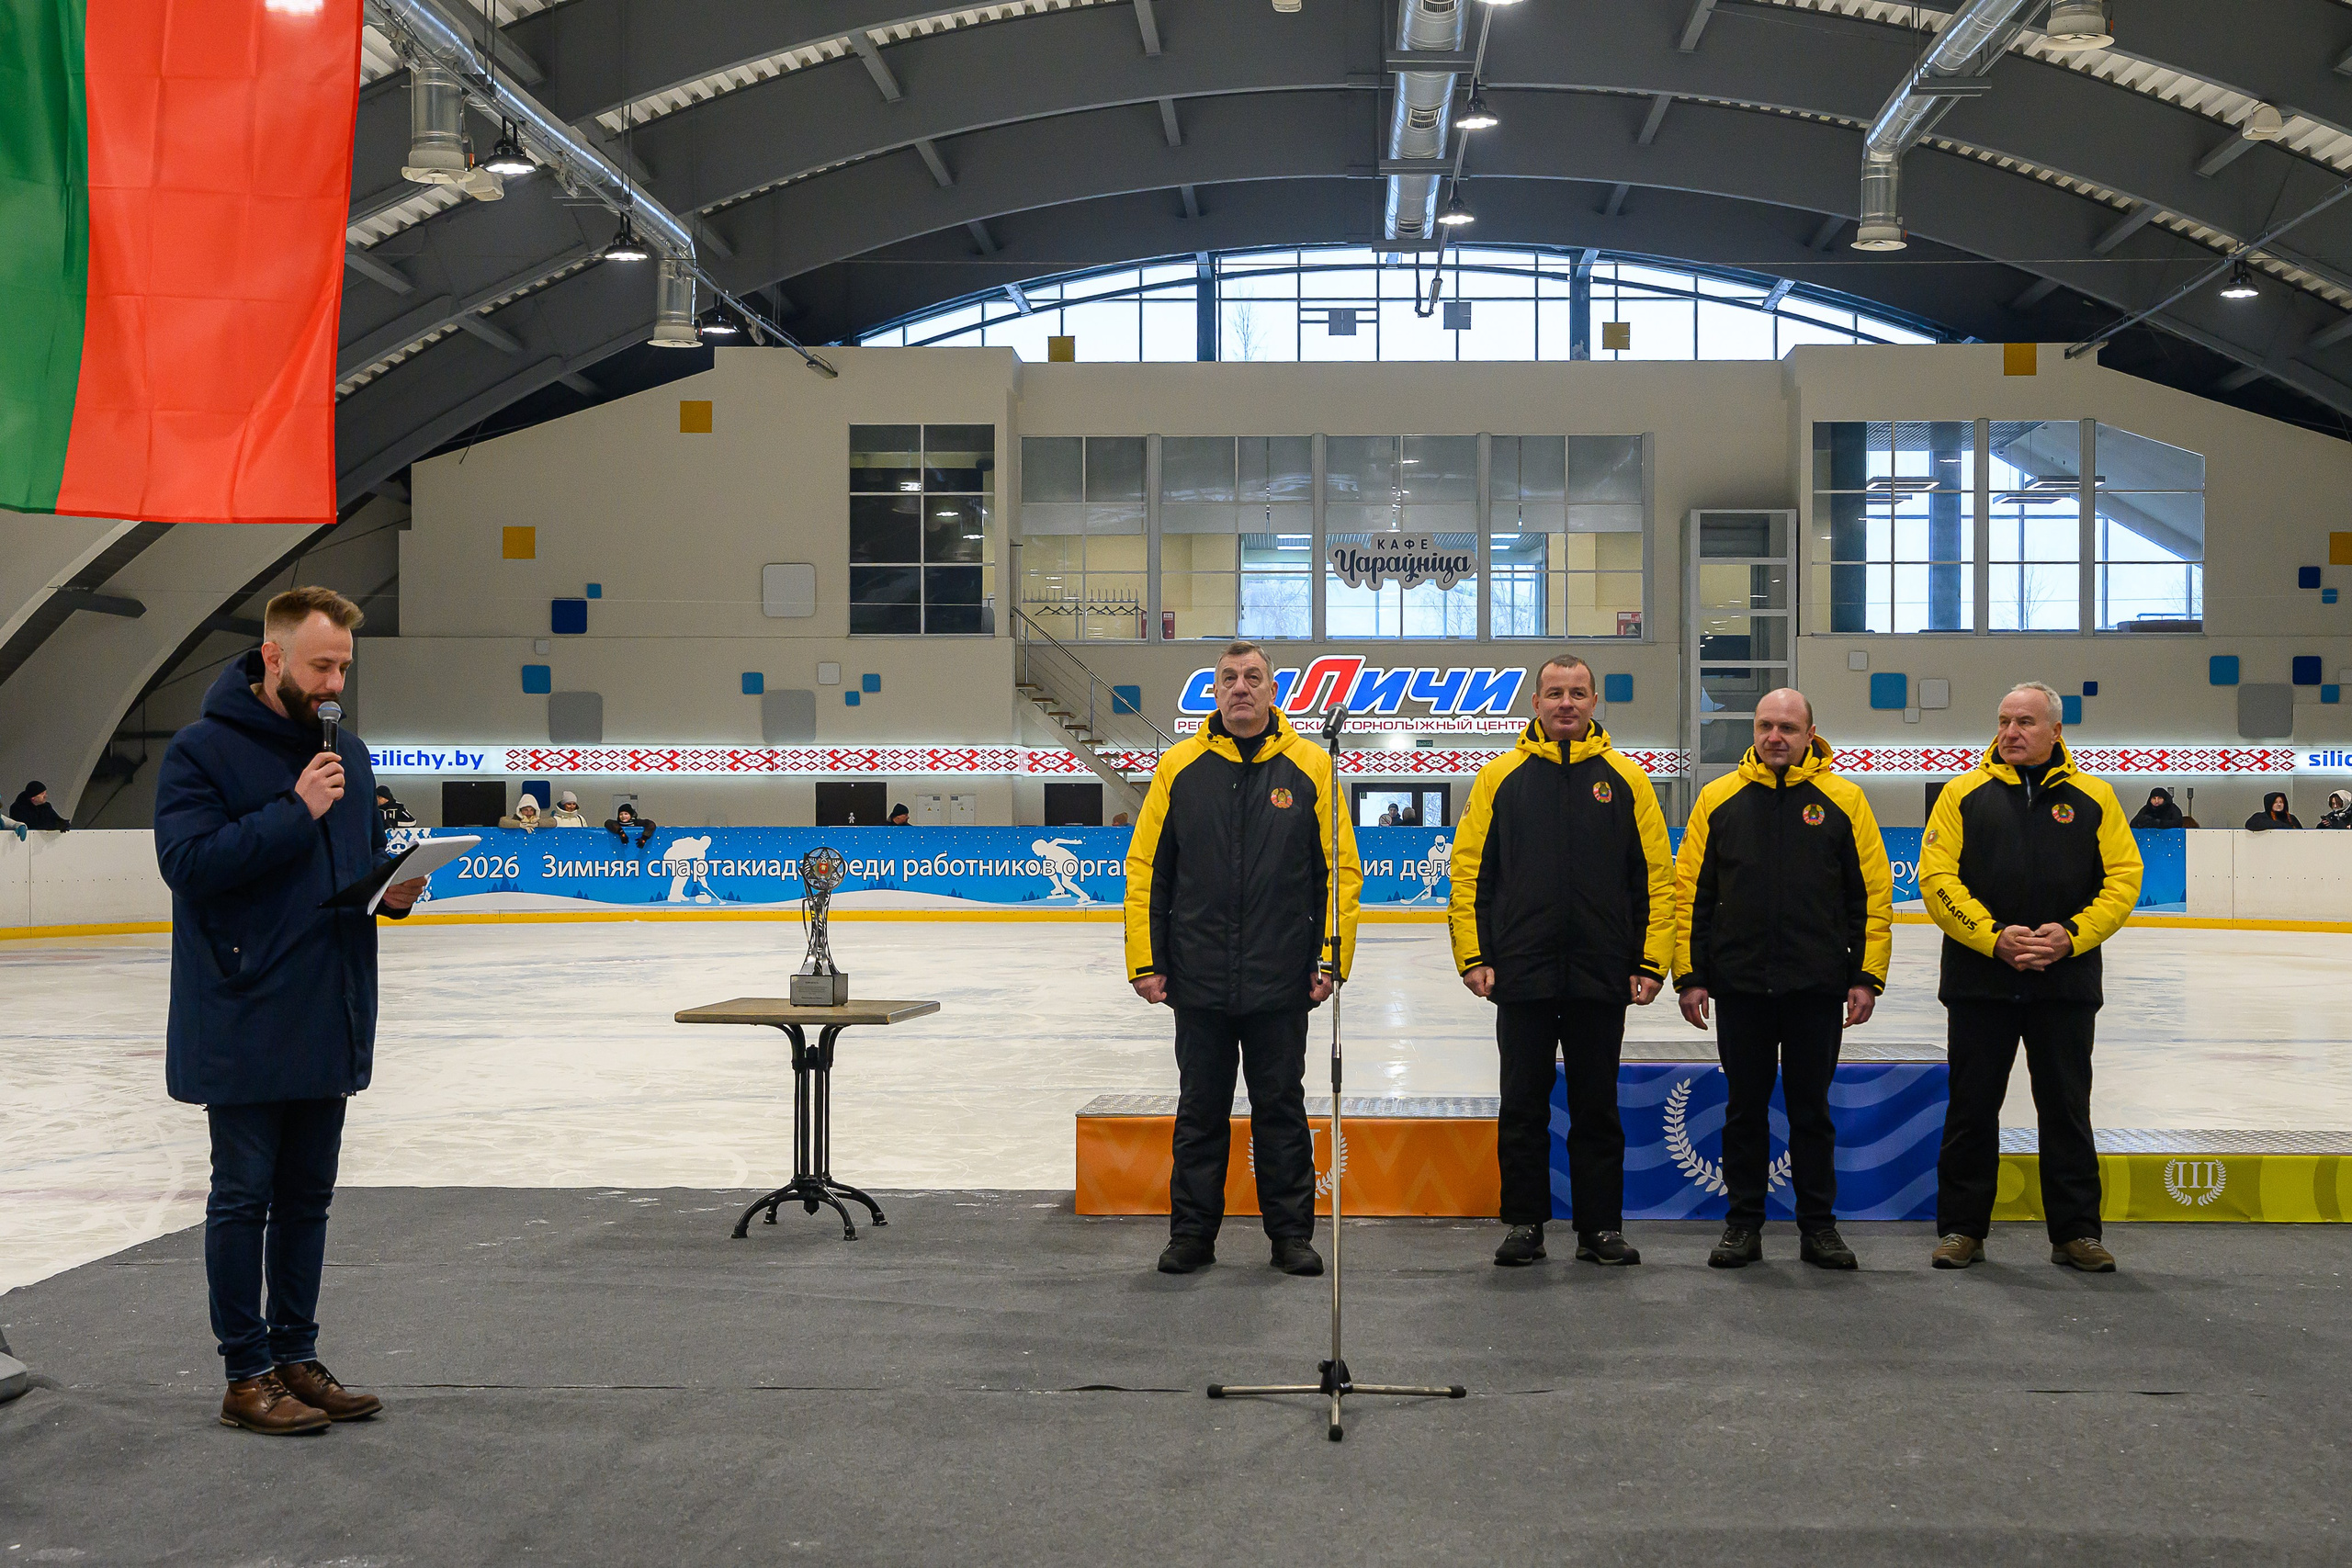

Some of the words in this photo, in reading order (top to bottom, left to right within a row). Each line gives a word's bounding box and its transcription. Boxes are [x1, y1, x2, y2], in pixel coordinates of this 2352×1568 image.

[1377, 538, 1429, 550] КАФЕ
[1334, 548, 1472, 584] Чараўніца
[1343, 718, 1473, 731] ГОРНОЛЫЖНЫЙ
[1476, 720, 1527, 733] ЦЕНТР
[369, 750, 485, 771] silichy.by
[457, 854, 522, 880] 2026
[541, 854, 640, 878] Зимняя
[844, 858, 896, 882] еди
[902, 851, 1057, 883] работников
[1062, 858, 1126, 883] орга
[1936, 887, 1978, 931] BELARUS
